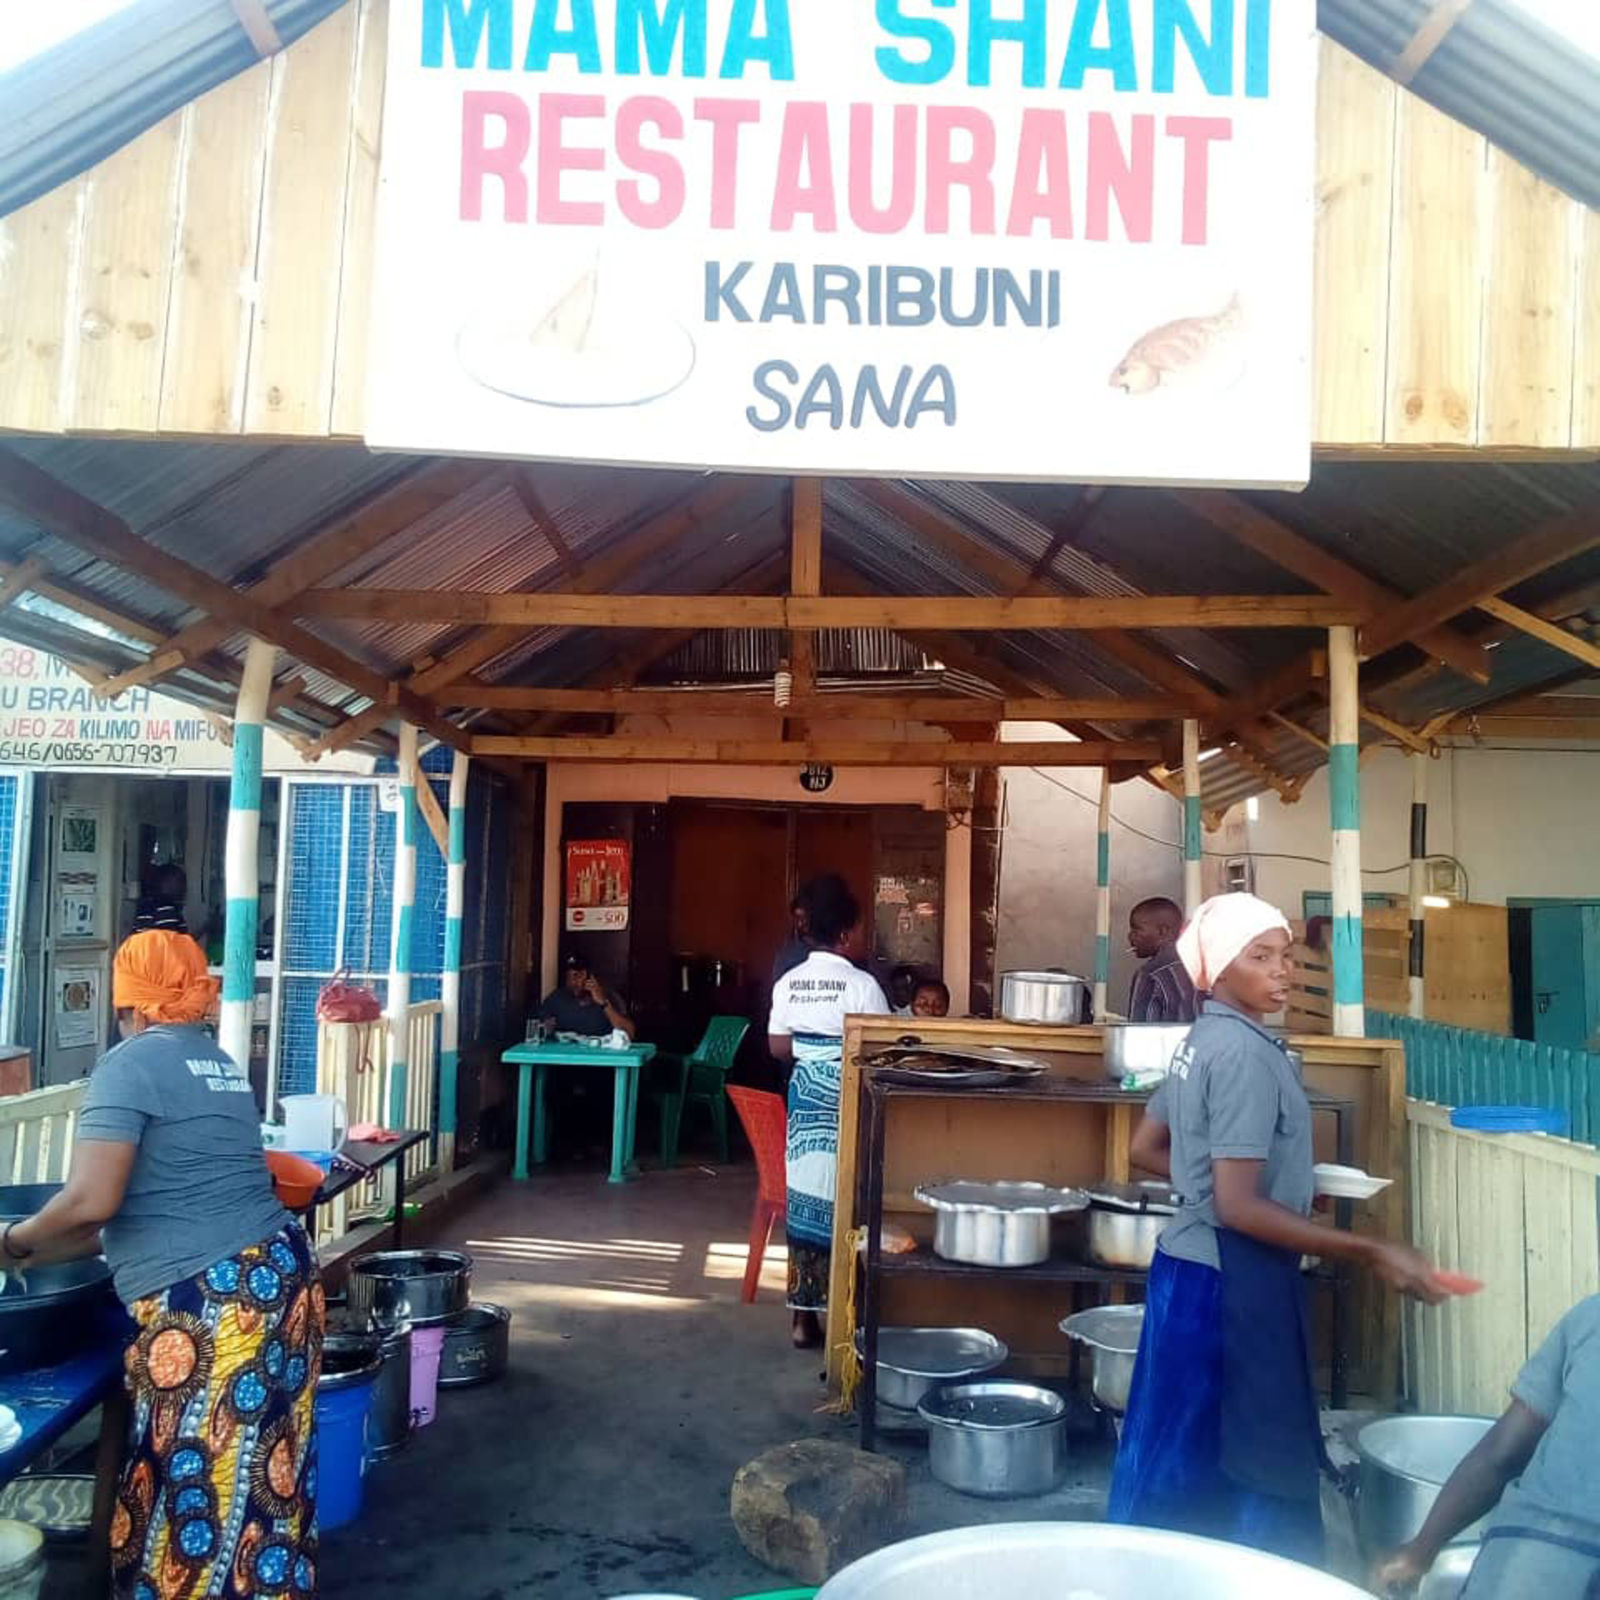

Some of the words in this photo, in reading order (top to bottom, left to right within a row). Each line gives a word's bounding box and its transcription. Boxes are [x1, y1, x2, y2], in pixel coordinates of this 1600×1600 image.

[420, 0, 796, 82] MAMA
[876, 0, 1271, 99] SHANI
[459, 91, 1234, 246] RESTAURANT
[703, 260, 1062, 329] KARIBUNI
[745, 358, 958, 433] SANA
[51, 719, 76, 739] ZA
[80, 719, 141, 740] KILIMO
[145, 719, 171, 740] NA
